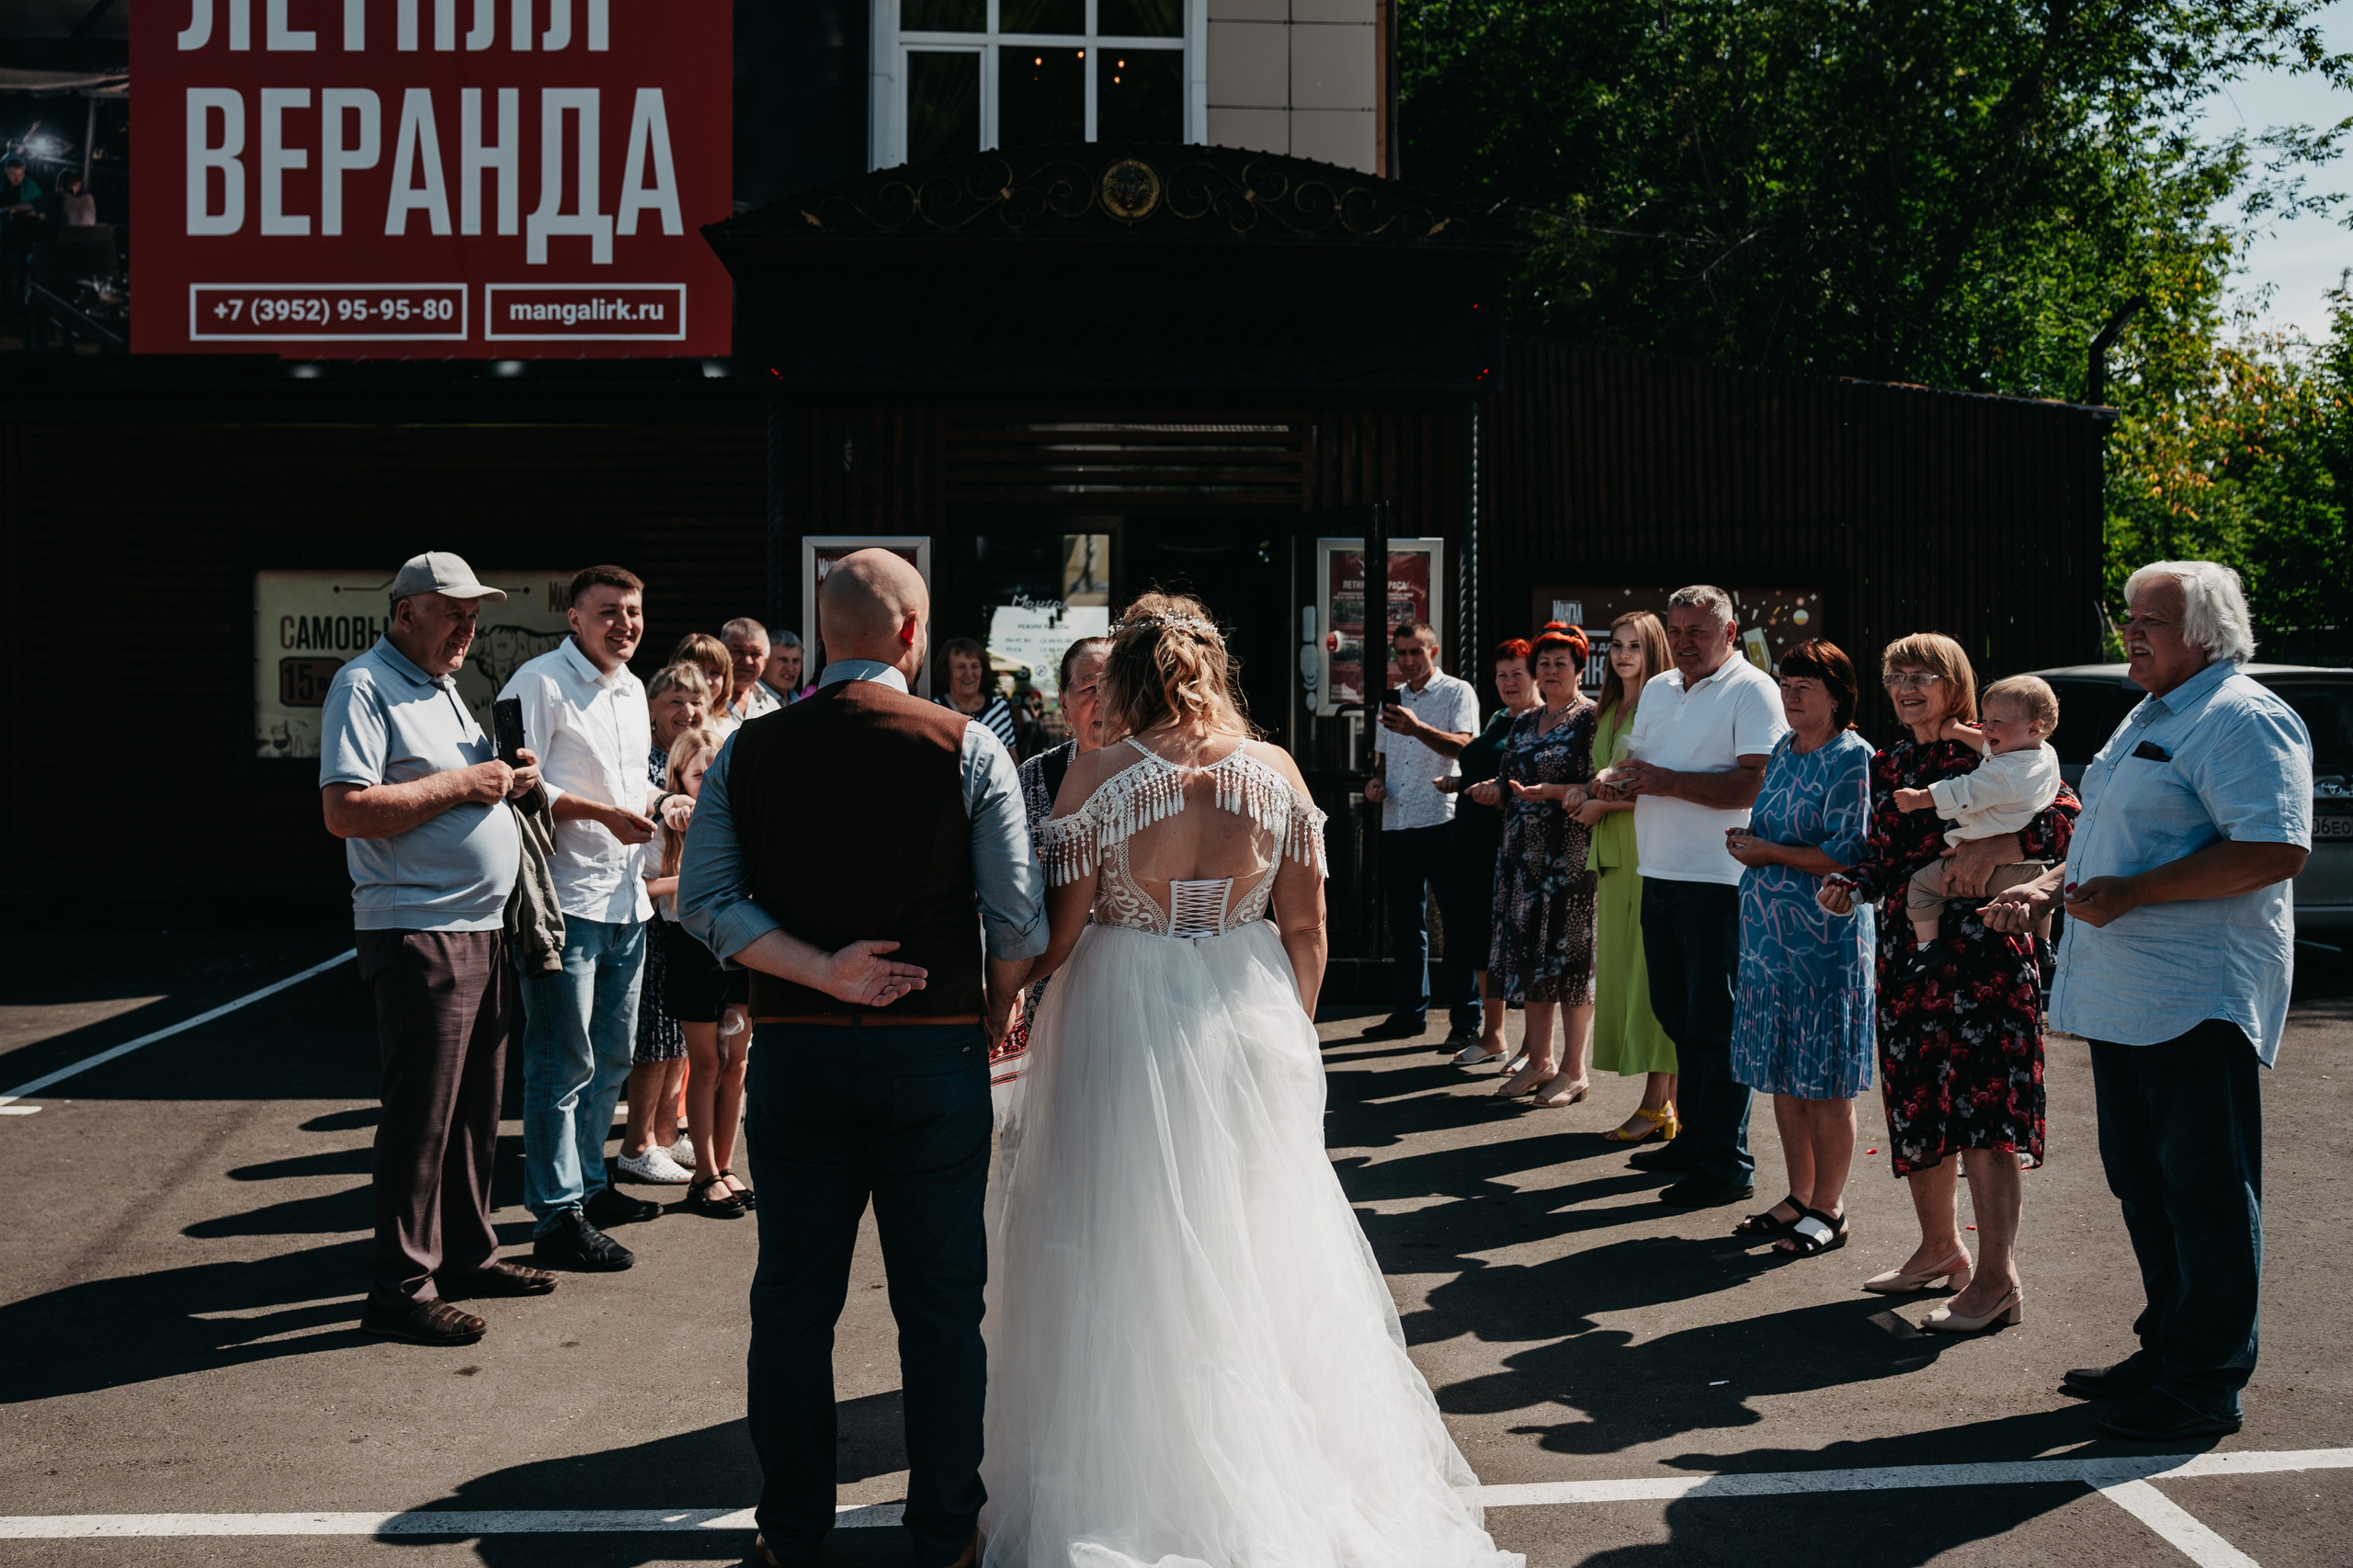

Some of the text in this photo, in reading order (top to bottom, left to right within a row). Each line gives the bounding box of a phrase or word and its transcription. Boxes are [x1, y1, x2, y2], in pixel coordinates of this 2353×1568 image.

[187, 87, 684, 265] ВЕРАНДА
[214, 297, 453, 325] +7 (3952) 95-95-80
[509, 298, 664, 325] mangalirk.ru
[1343, 580, 1407, 590] ЛЕТНЯ РАСА
[279, 615, 390, 650] САМОВЫ
